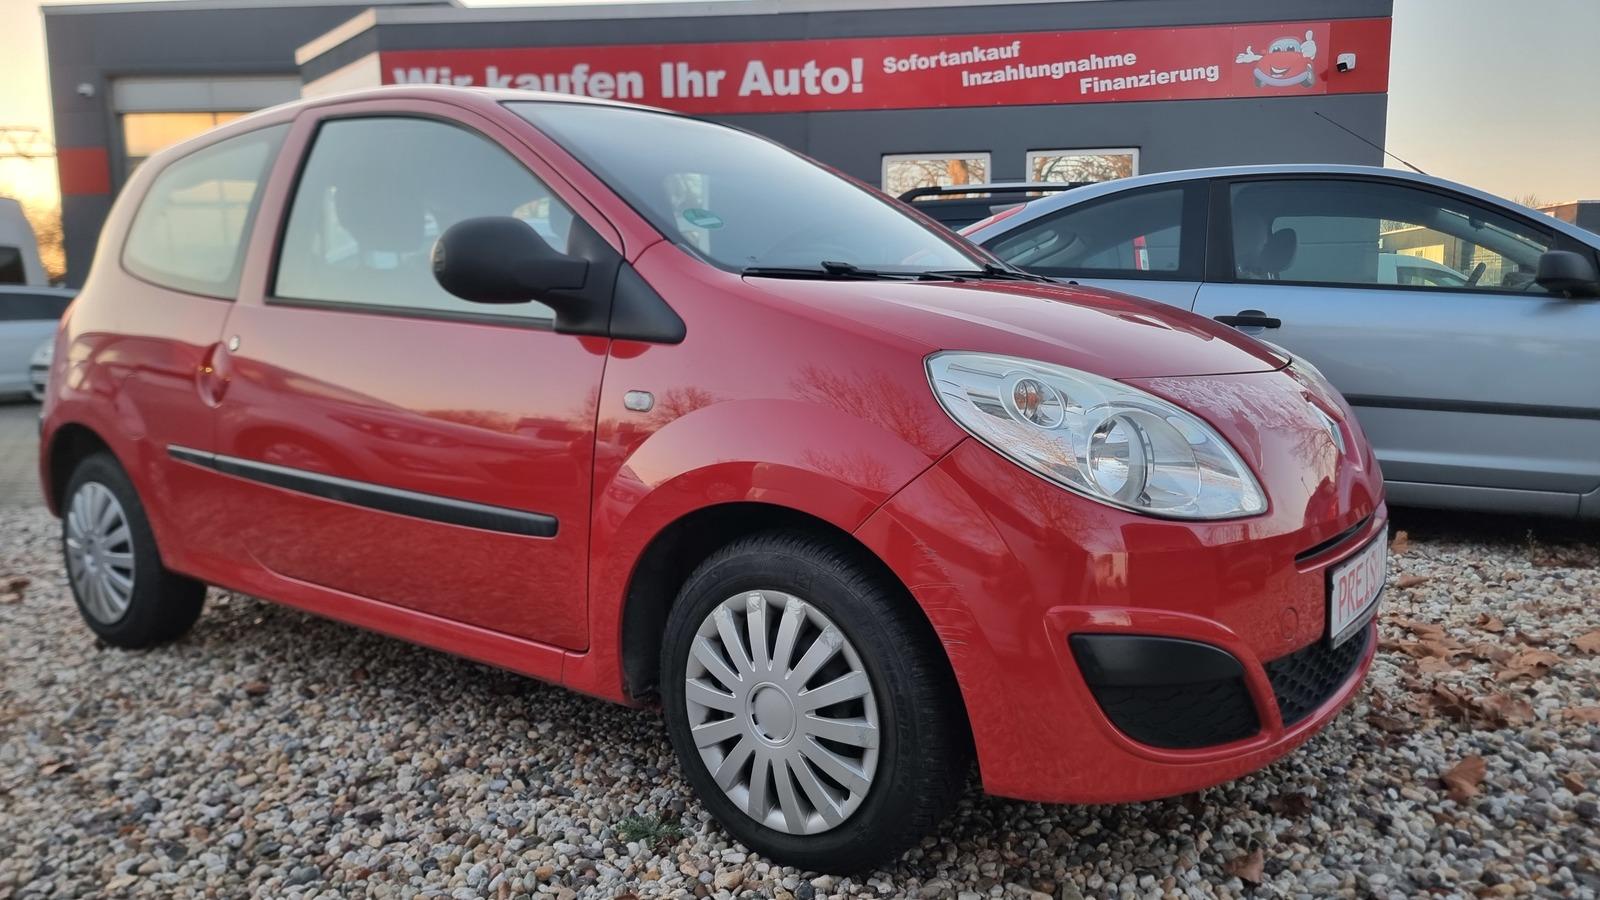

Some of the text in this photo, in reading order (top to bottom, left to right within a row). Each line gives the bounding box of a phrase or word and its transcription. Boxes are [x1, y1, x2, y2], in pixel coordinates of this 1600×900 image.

[883, 41, 1021, 74] Sofortankauf
[962, 52, 1137, 87] Inzahlungnahme
[485, 63, 644, 99] kaufen
[661, 62, 726, 98] Ihr
[738, 58, 864, 96] Auto!
[1079, 64, 1220, 95] Finanzierung
